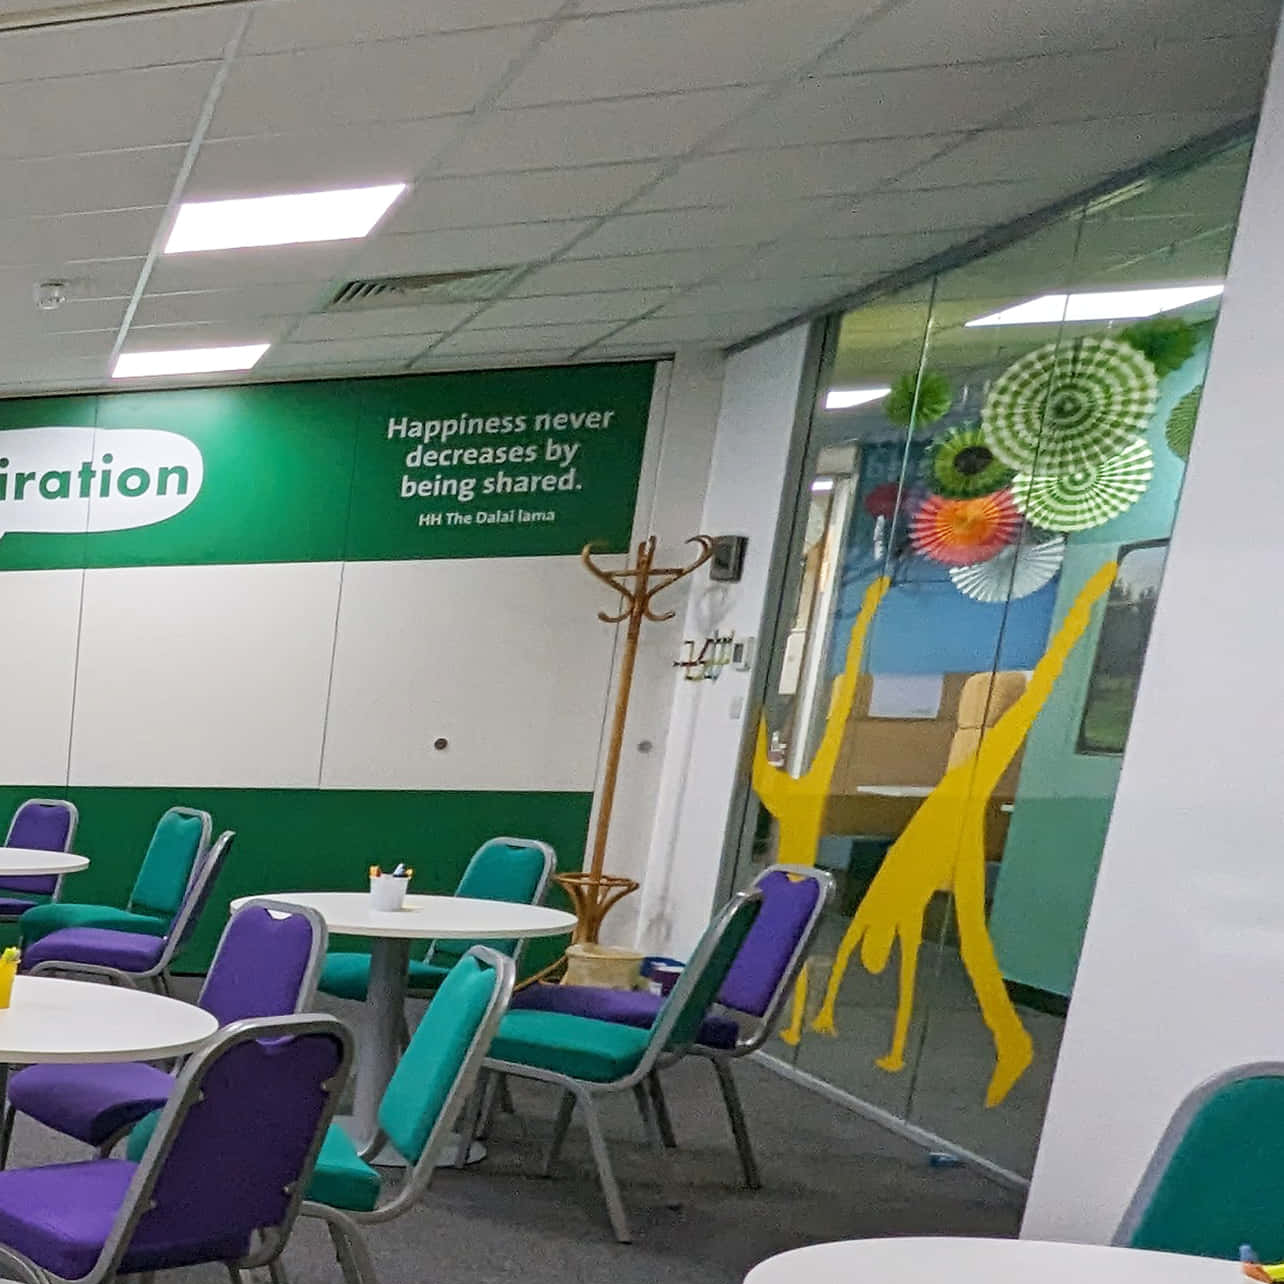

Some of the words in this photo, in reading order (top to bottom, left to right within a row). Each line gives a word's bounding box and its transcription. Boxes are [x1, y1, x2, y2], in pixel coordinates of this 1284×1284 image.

[387, 413, 527, 443] Happiness
[535, 410, 615, 431] never
[405, 444, 537, 468] decreases
[545, 438, 580, 468] by
[400, 474, 476, 501] being
[482, 468, 582, 494] shared.
[418, 513, 442, 526] HH
[445, 511, 472, 525] The
[476, 509, 513, 524] Dalai
[518, 509, 555, 522] lama
